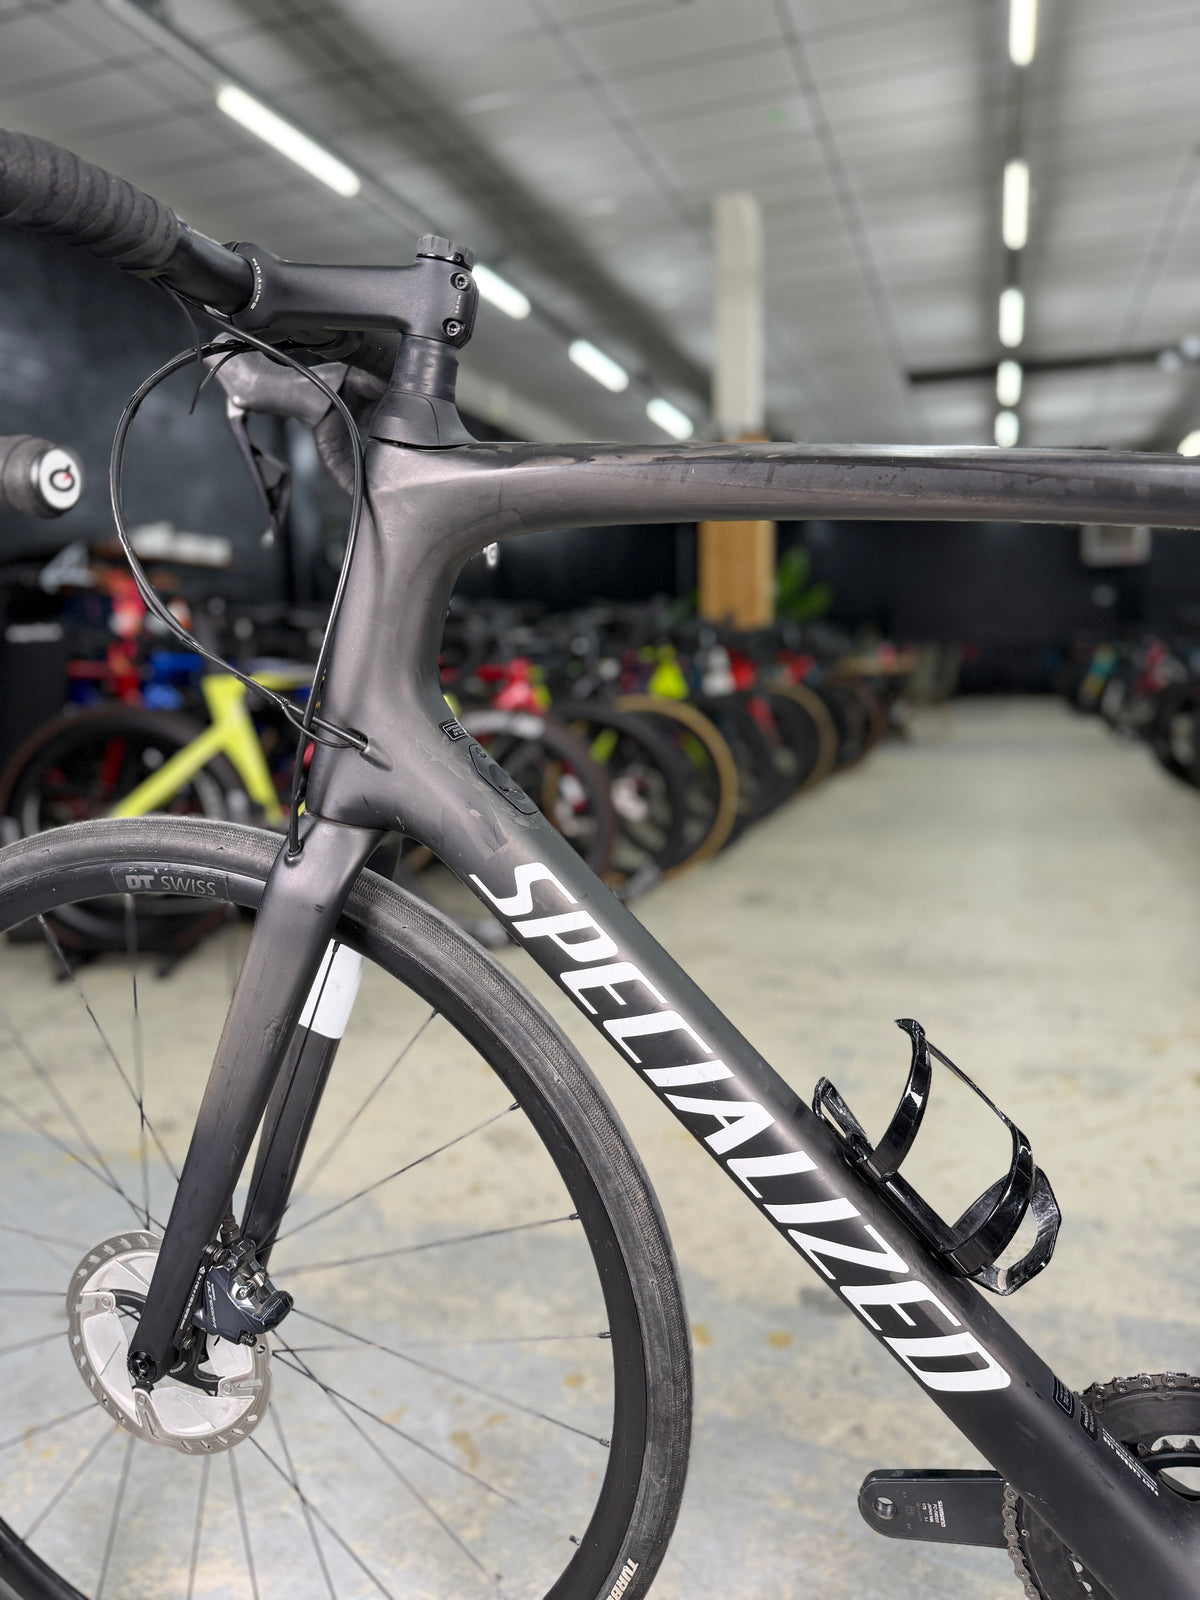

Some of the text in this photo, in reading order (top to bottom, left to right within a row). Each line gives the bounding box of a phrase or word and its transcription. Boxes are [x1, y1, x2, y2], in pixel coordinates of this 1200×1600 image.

[125, 875, 217, 896] DT SWISS
[468, 862, 1011, 1392] SPECIALIZED
[206, 1280, 217, 1329] ULTEGRA
[937, 1500, 946, 1528] SHIMANO
[606, 1557, 640, 1600] TURB
